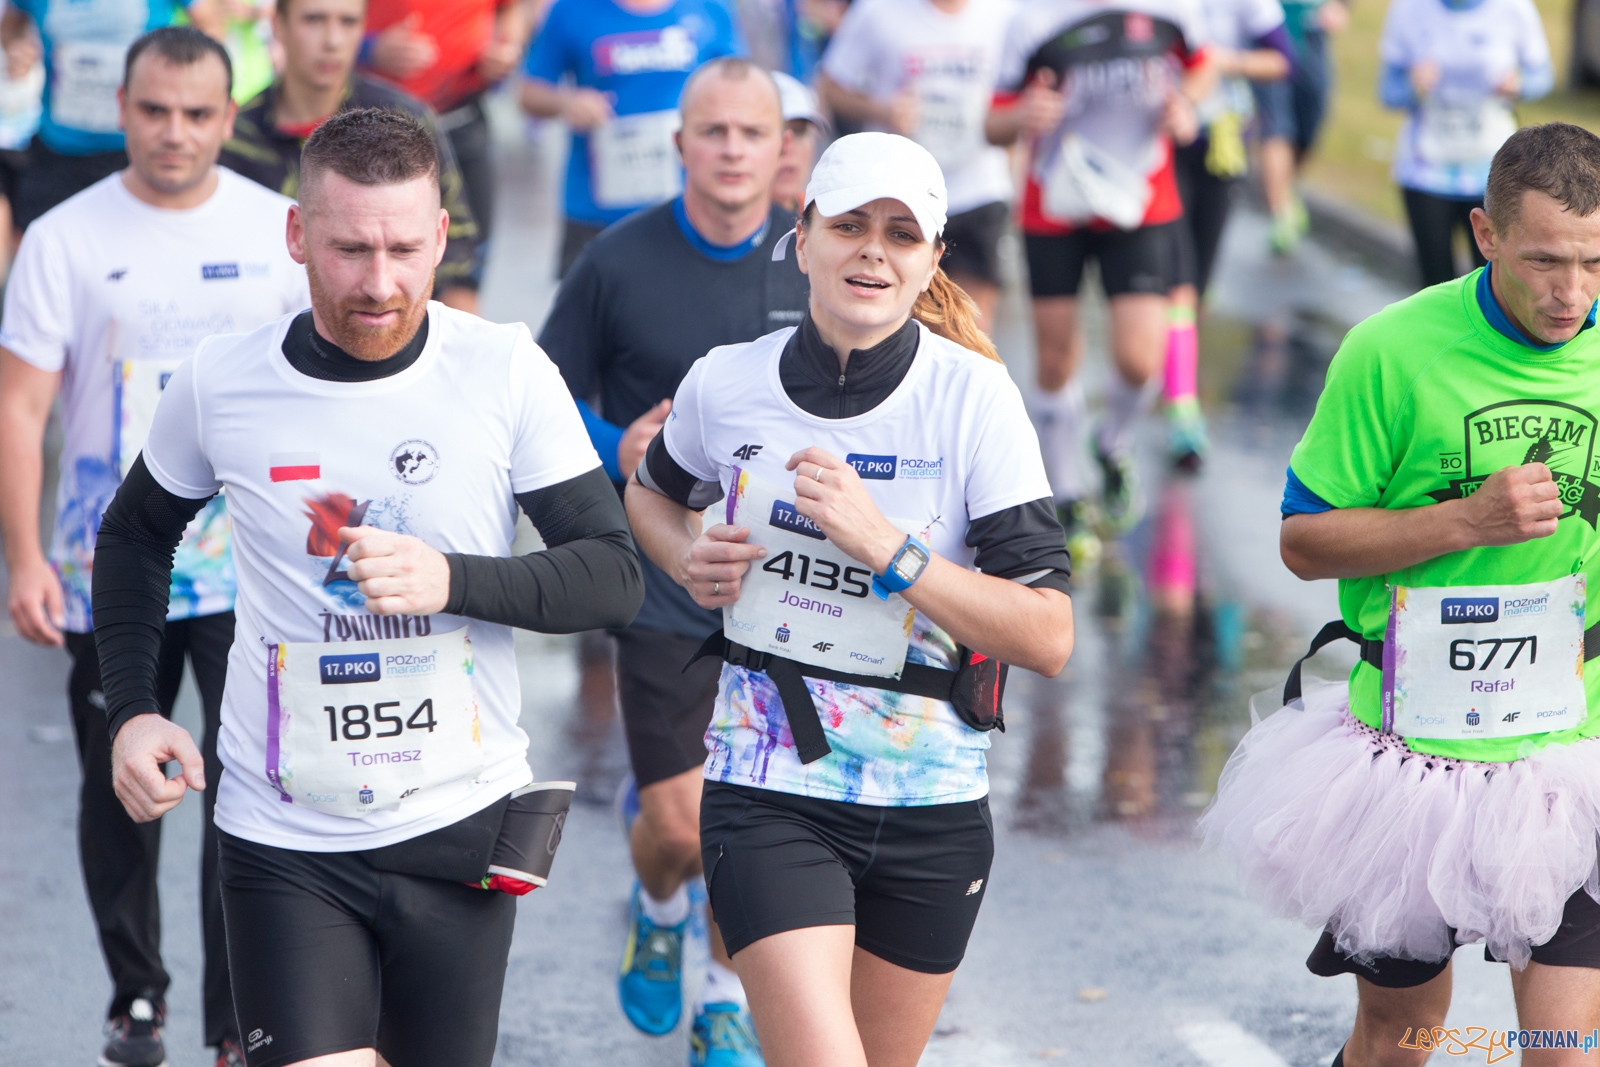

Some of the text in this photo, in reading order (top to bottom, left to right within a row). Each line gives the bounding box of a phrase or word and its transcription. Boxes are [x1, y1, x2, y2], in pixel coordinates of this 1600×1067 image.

[1473, 415, 1588, 446] BIEGAM
[733, 444, 763, 460] 4F
[867, 462, 892, 473] PKO
[1440, 458, 1462, 469] BO
[900, 468, 941, 476] maraton
[778, 509, 793, 523] 17.
[762, 551, 871, 598] 4135
[778, 590, 843, 618] Joanna
[1447, 605, 1464, 616] 17.
[1466, 604, 1494, 616] PKO
[1504, 604, 1547, 616] maraton
[812, 641, 834, 653] 4F
[1449, 635, 1537, 672] 6771
[325, 661, 376, 676] 17. PKO
[386, 663, 436, 675] maraton
[1471, 678, 1515, 693] Rafał
[323, 698, 438, 742] 1854
[1502, 712, 1521, 722] 4F
[347, 750, 422, 767] Tomasz
